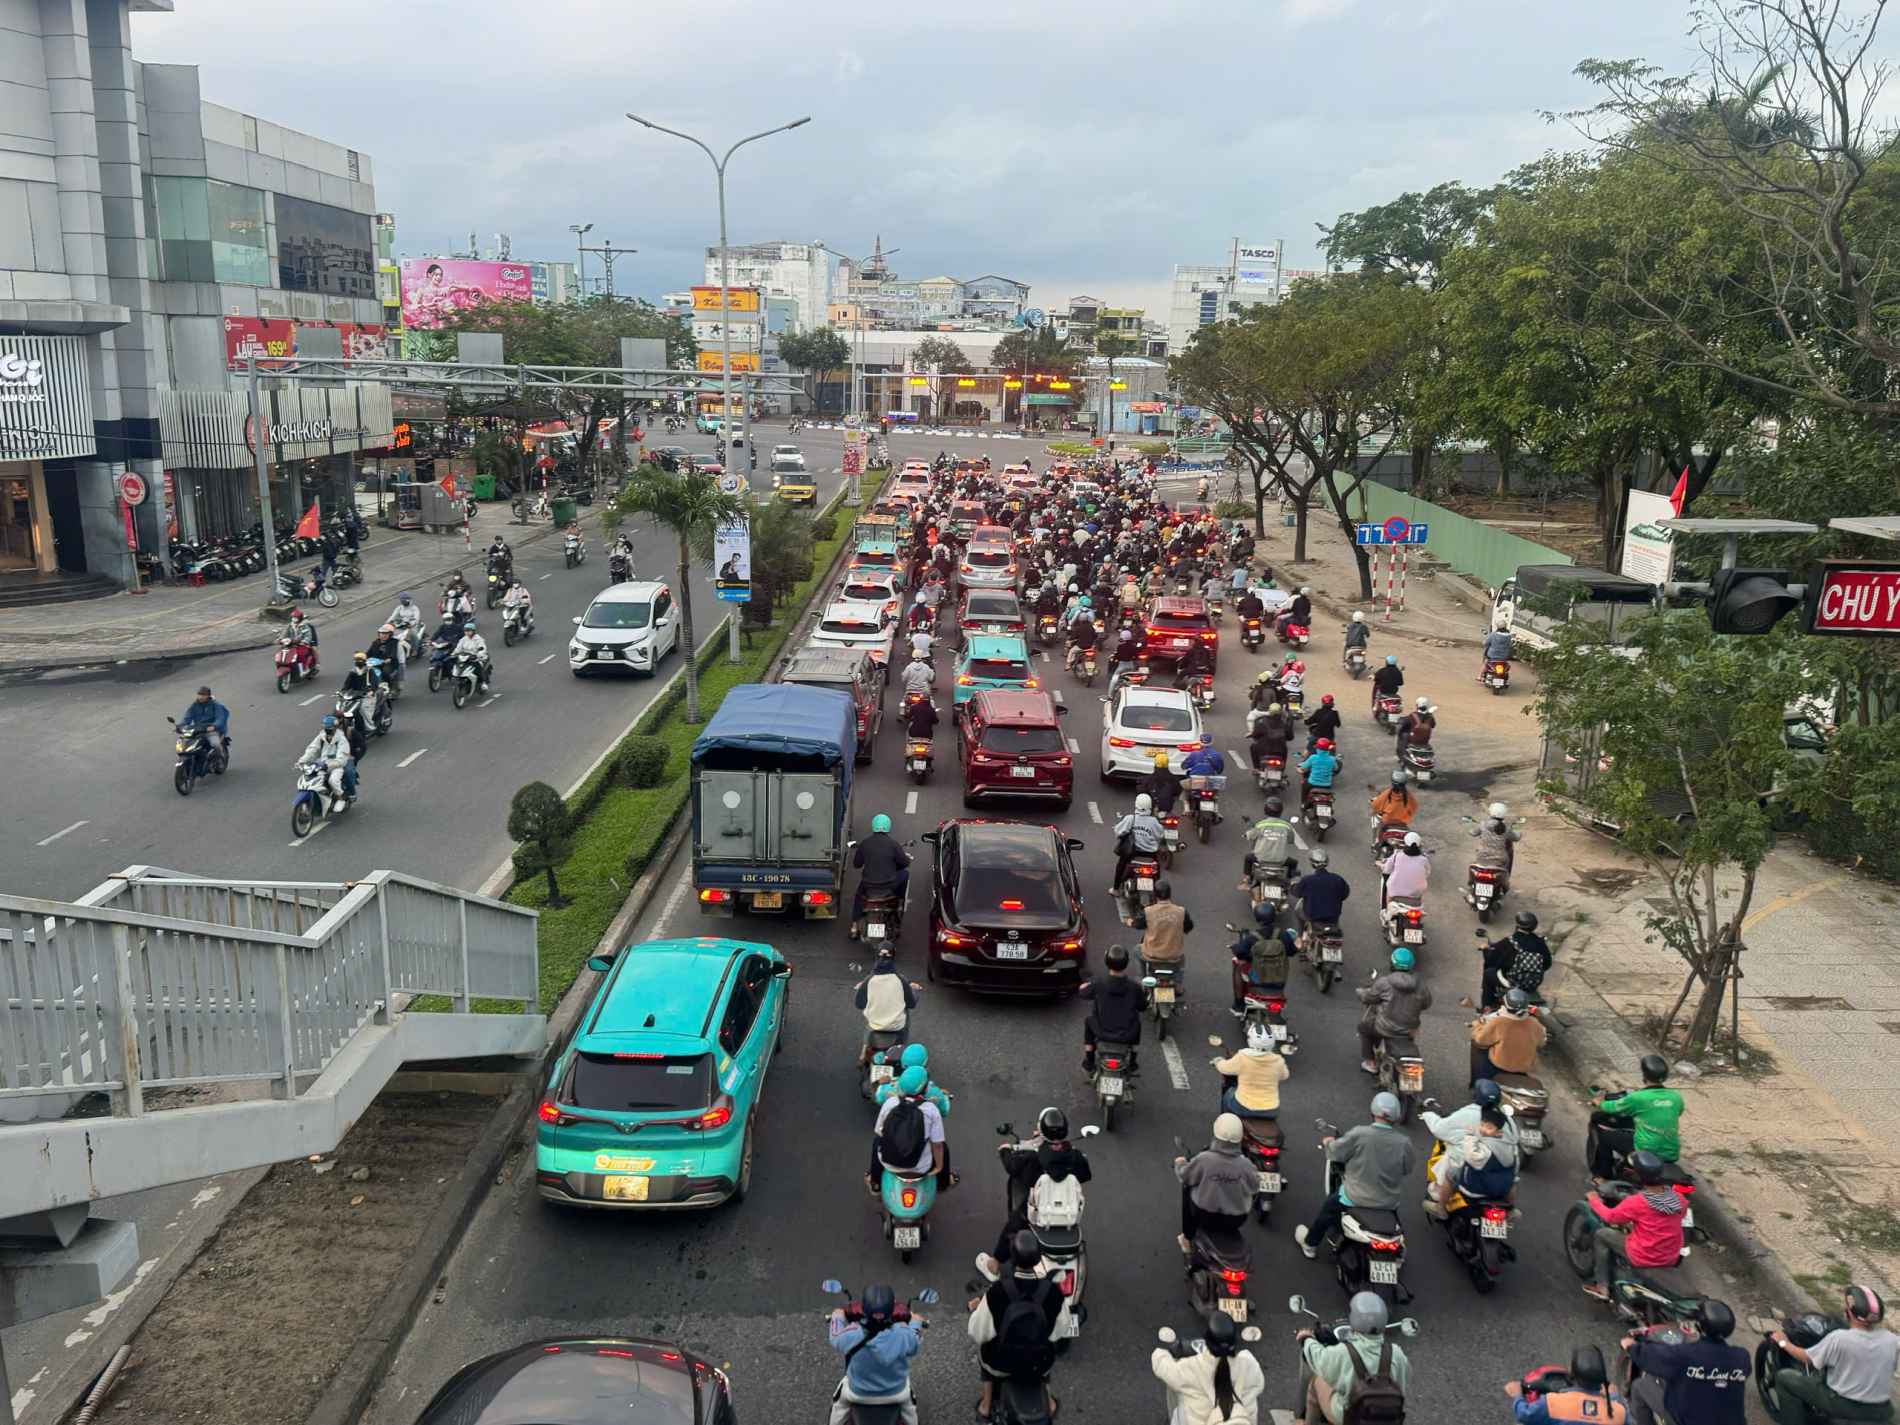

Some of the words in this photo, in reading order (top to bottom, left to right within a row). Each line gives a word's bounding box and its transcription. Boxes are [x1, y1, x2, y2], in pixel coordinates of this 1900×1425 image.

[1240, 248, 1275, 258] TASCO
[269, 419, 332, 443] KICHI-KICHI
[1821, 576, 1882, 622] CHÚ
